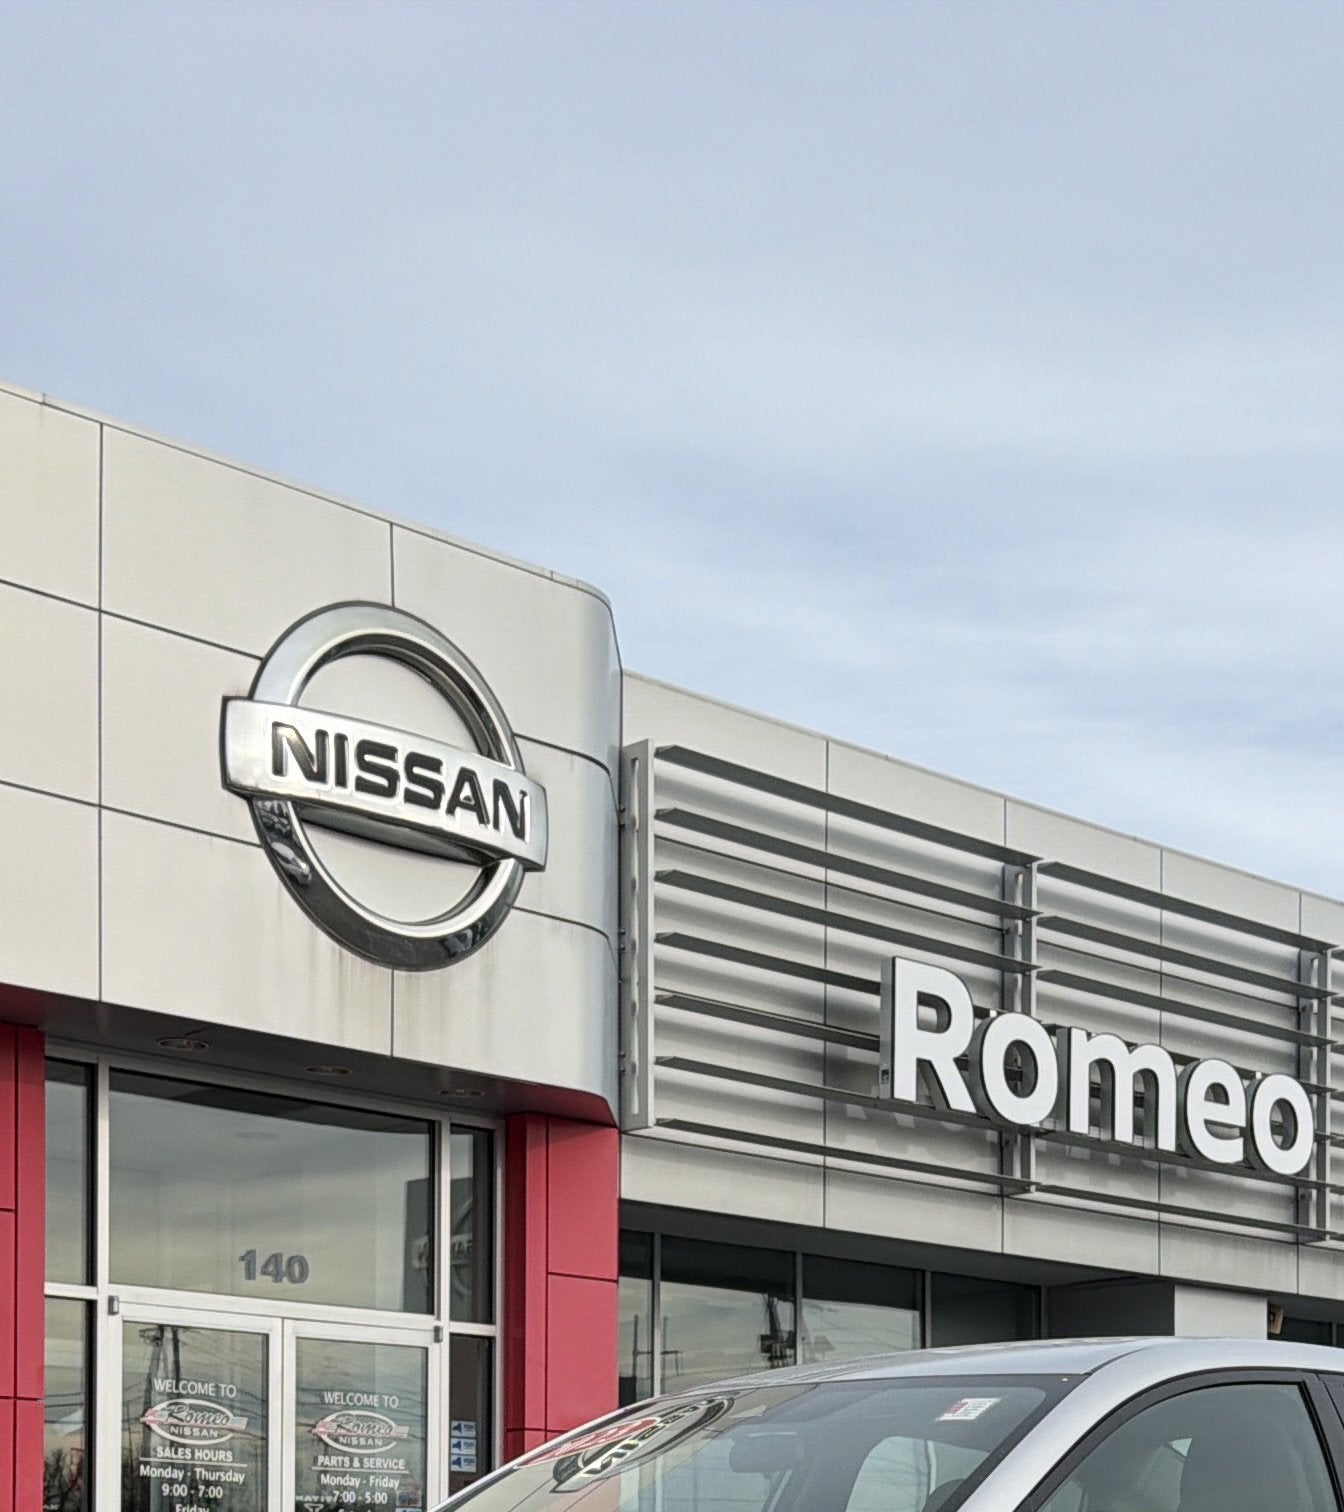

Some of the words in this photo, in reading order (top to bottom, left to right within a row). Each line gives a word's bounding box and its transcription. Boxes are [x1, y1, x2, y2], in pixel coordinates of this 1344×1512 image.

[271, 720, 529, 843] NISSAN
[882, 956, 1314, 1176] Romeo
[238, 1249, 310, 1285] 140
[154, 1378, 216, 1396] WELCOME
[218, 1383, 237, 1398] TO
[323, 1391, 380, 1407] WELCOME
[382, 1395, 399, 1408] TO
[166, 1402, 231, 1425] Romeo
[170, 1426, 218, 1437] NISSAN
[335, 1415, 393, 1435] Romeo
[339, 1436, 383, 1446] NISSAN
[156, 1446, 192, 1460] SALES
[194, 1448, 233, 1462] HOURS
[318, 1455, 350, 1468] PARTS
[352, 1457, 361, 1468] &
[363, 1457, 405, 1470] SERVICE
[140, 1464, 185, 1481] Monday
[194, 1467, 245, 1485] Thursday
[320, 1473, 361, 1488] Monday
[369, 1475, 400, 1490] Friday
[161, 1483, 188, 1497] 9:00
[198, 1485, 223, 1499] 7:00
[333, 1490, 356, 1503] 7:00
[365, 1491, 387, 1504] 5:00
